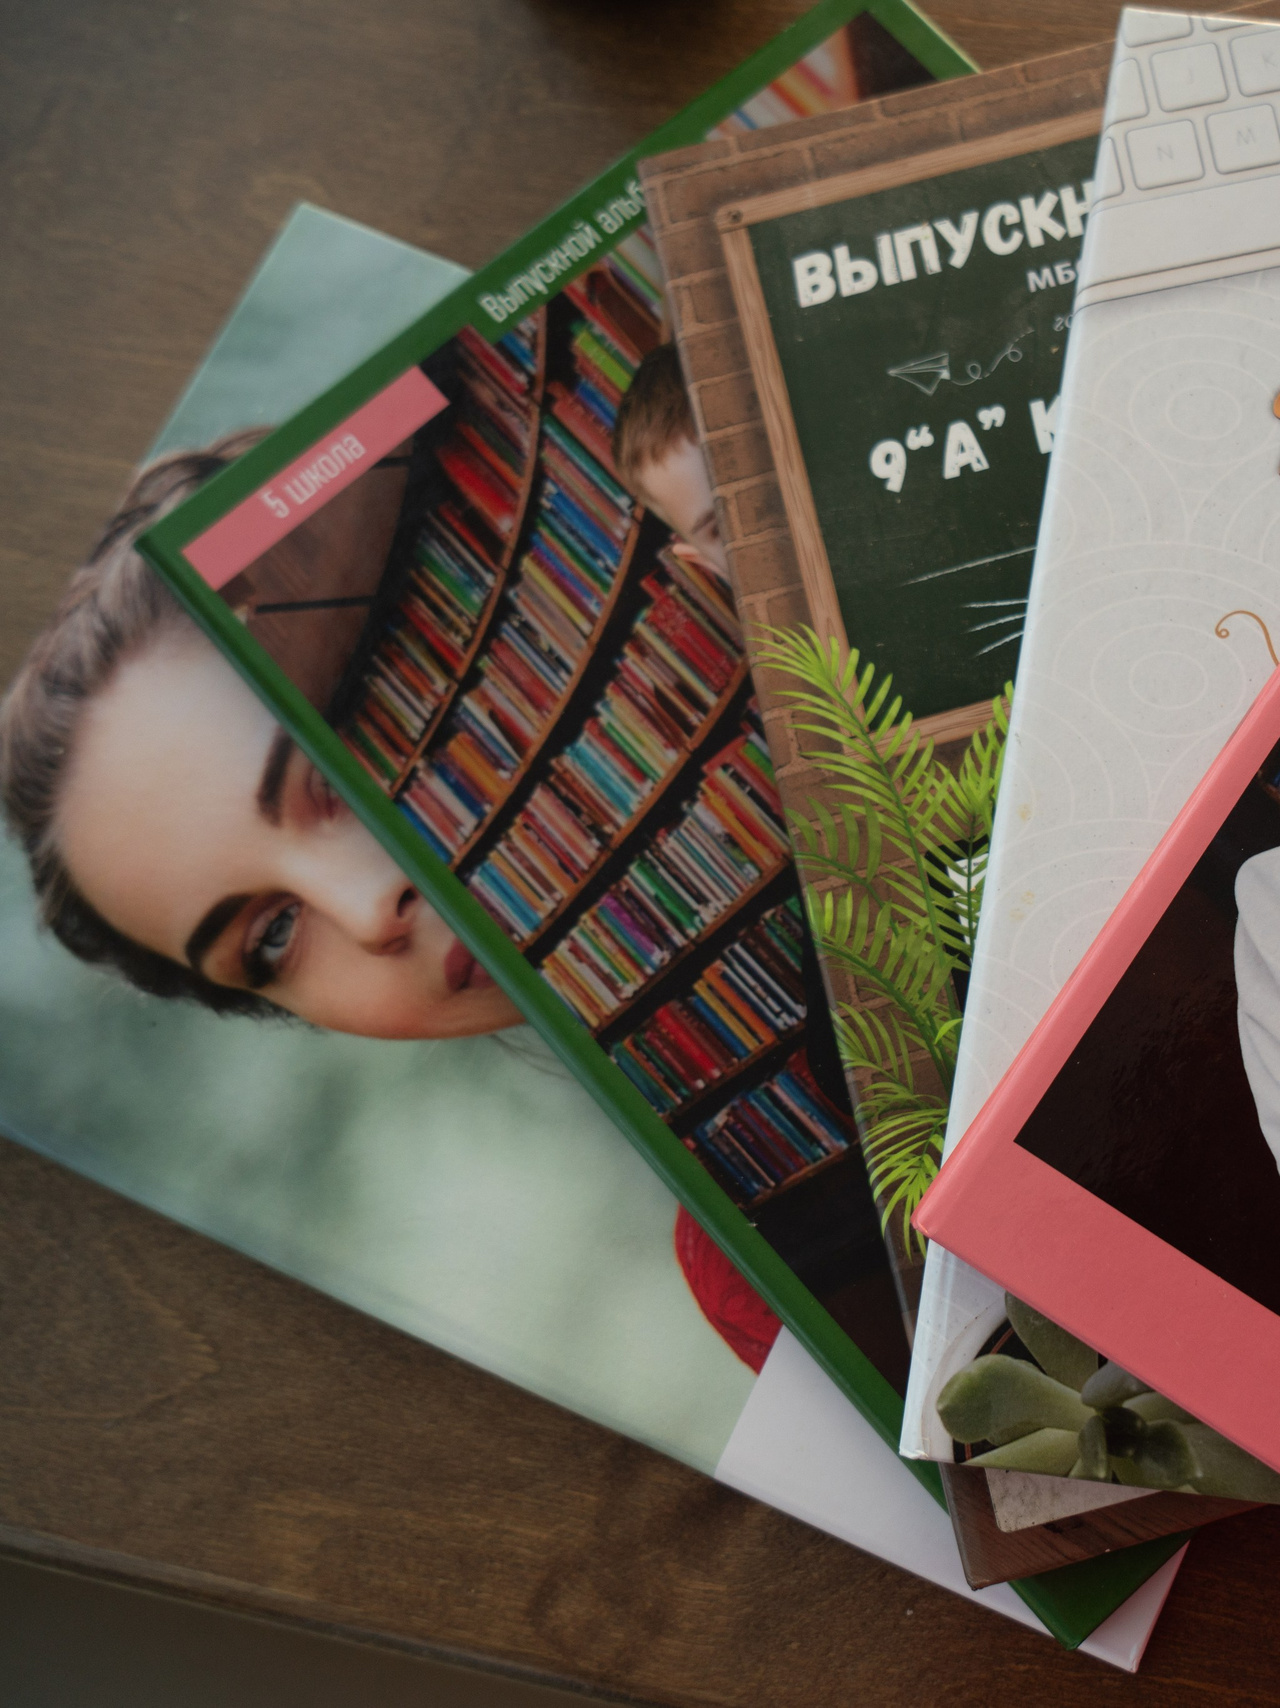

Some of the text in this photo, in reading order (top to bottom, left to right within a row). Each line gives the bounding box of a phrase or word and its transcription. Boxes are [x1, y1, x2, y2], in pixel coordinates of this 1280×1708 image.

[1260, 51, 1280, 70] K
[1156, 127, 1258, 162] N M
[478, 220, 603, 323] Выпускной
[1027, 261, 1081, 293] МБ
[261, 433, 367, 519] 5 школа
